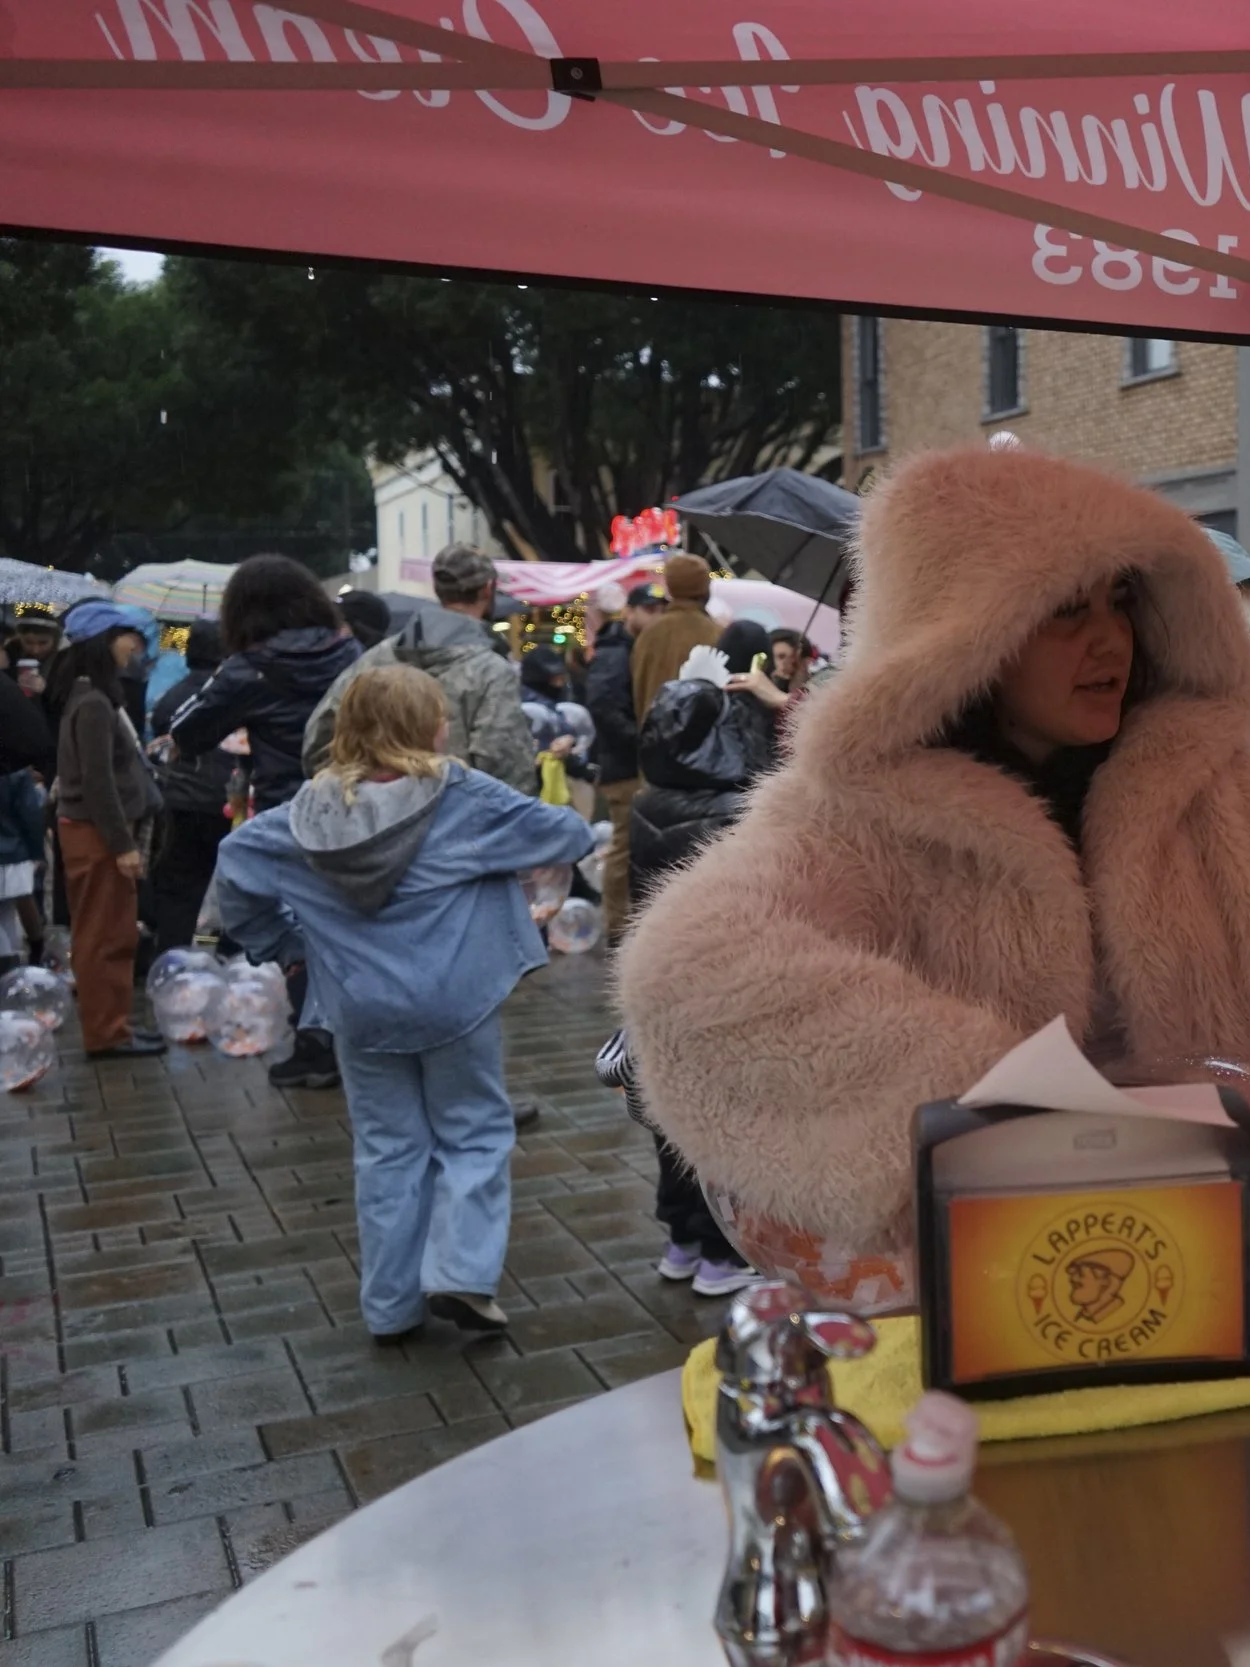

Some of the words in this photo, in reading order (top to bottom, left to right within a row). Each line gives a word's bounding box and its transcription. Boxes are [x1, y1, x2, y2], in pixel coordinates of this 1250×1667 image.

[1031, 1212, 1167, 1266] LAPPERT'S
[1033, 1313, 1072, 1350] ICE
[1078, 1309, 1167, 1358] CREAM
